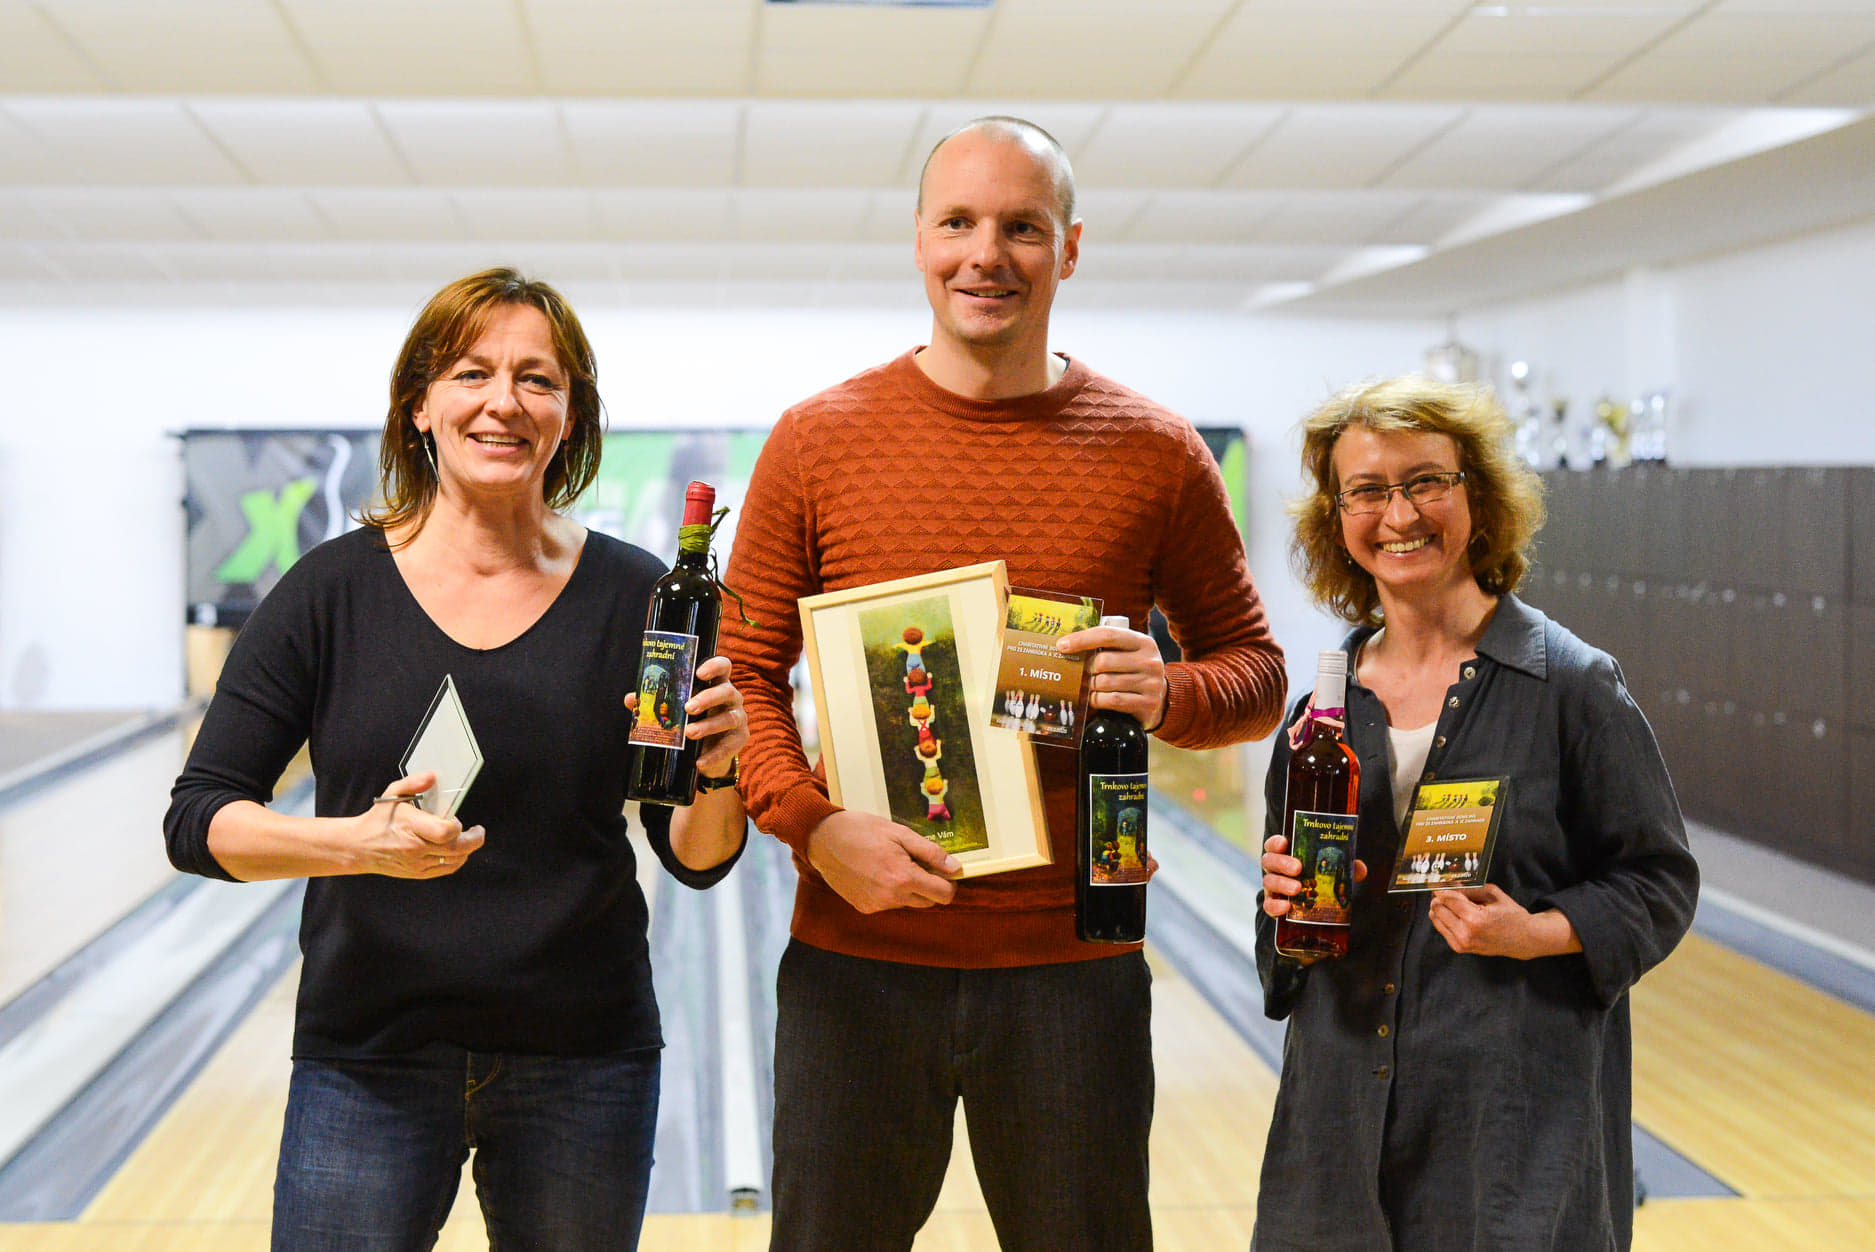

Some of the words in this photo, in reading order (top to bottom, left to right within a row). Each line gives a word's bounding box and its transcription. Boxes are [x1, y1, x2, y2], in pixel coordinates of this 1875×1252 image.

[1019, 667, 1028, 677] 1.
[1030, 668, 1061, 682] MÍSTO
[1436, 832, 1466, 842] MÍSTO
